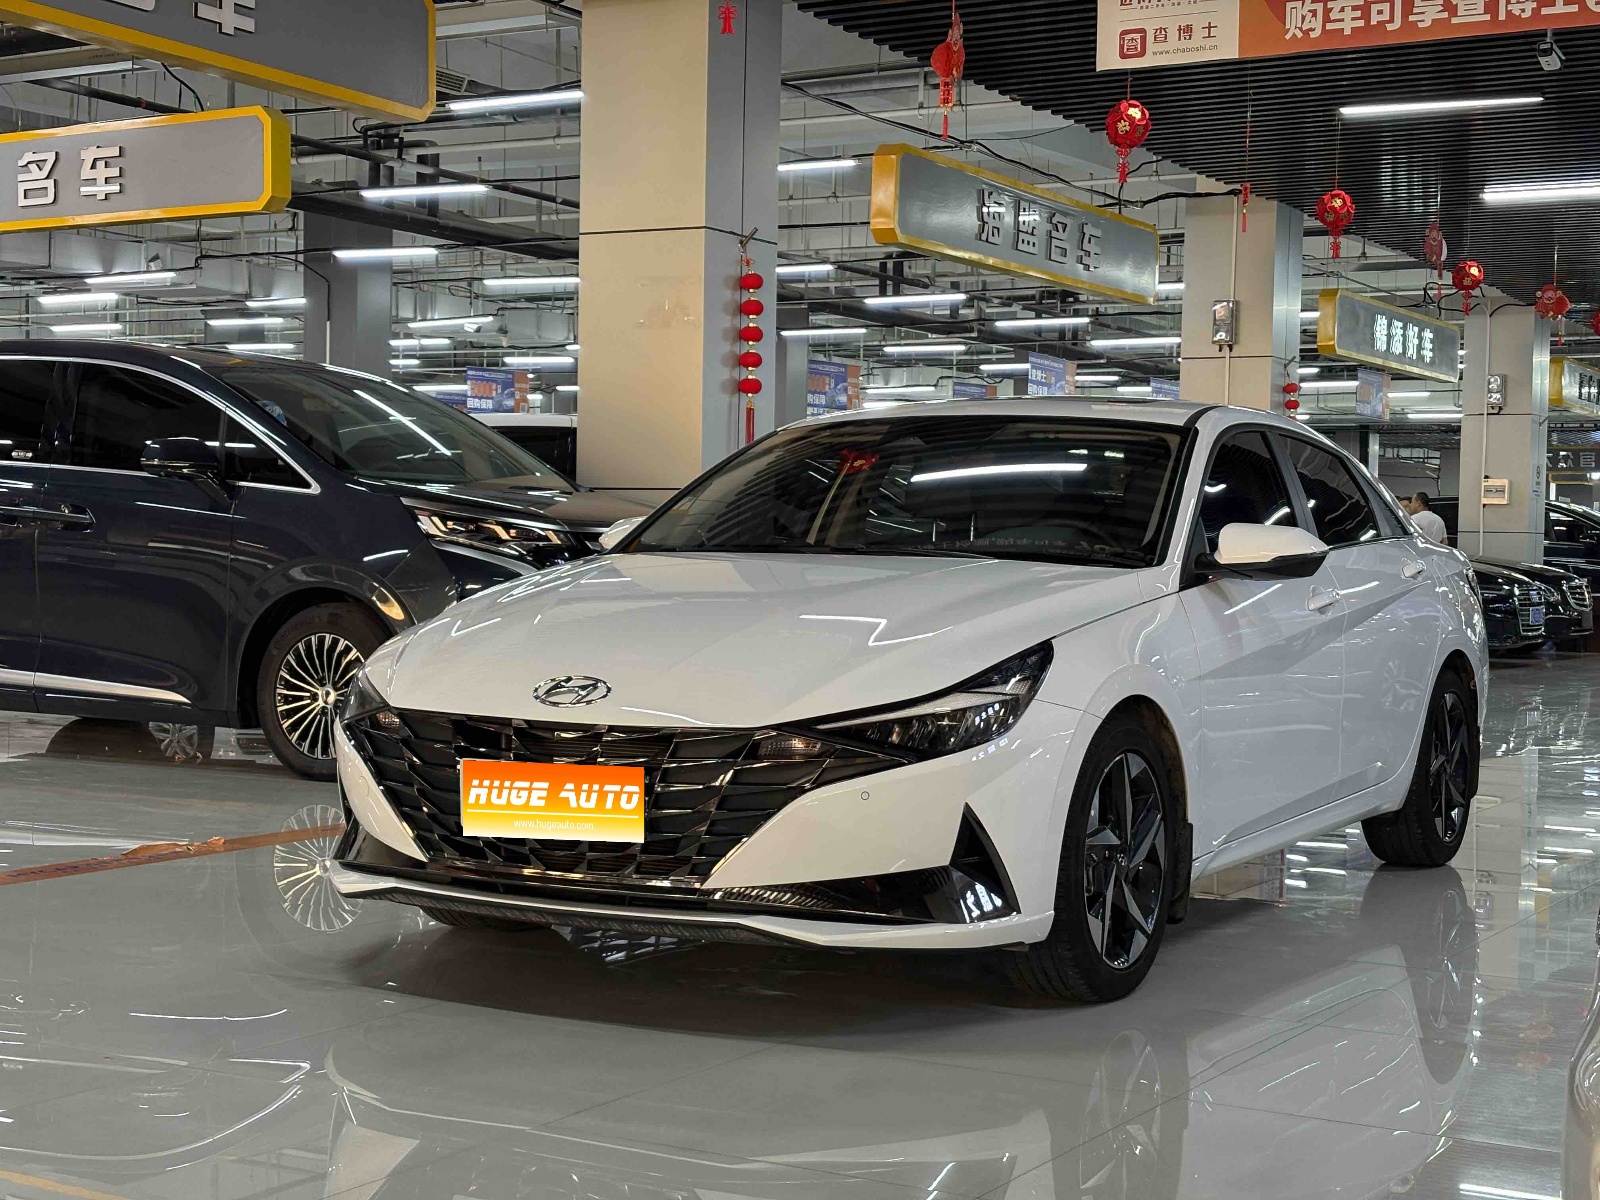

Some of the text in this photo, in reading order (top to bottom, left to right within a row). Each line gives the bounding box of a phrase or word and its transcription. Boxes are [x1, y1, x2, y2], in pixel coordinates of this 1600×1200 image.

[1152, 21, 1218, 44] 查博士
[1152, 43, 1218, 56] www.chaboshi.cn
[17, 145, 122, 207] 名车
